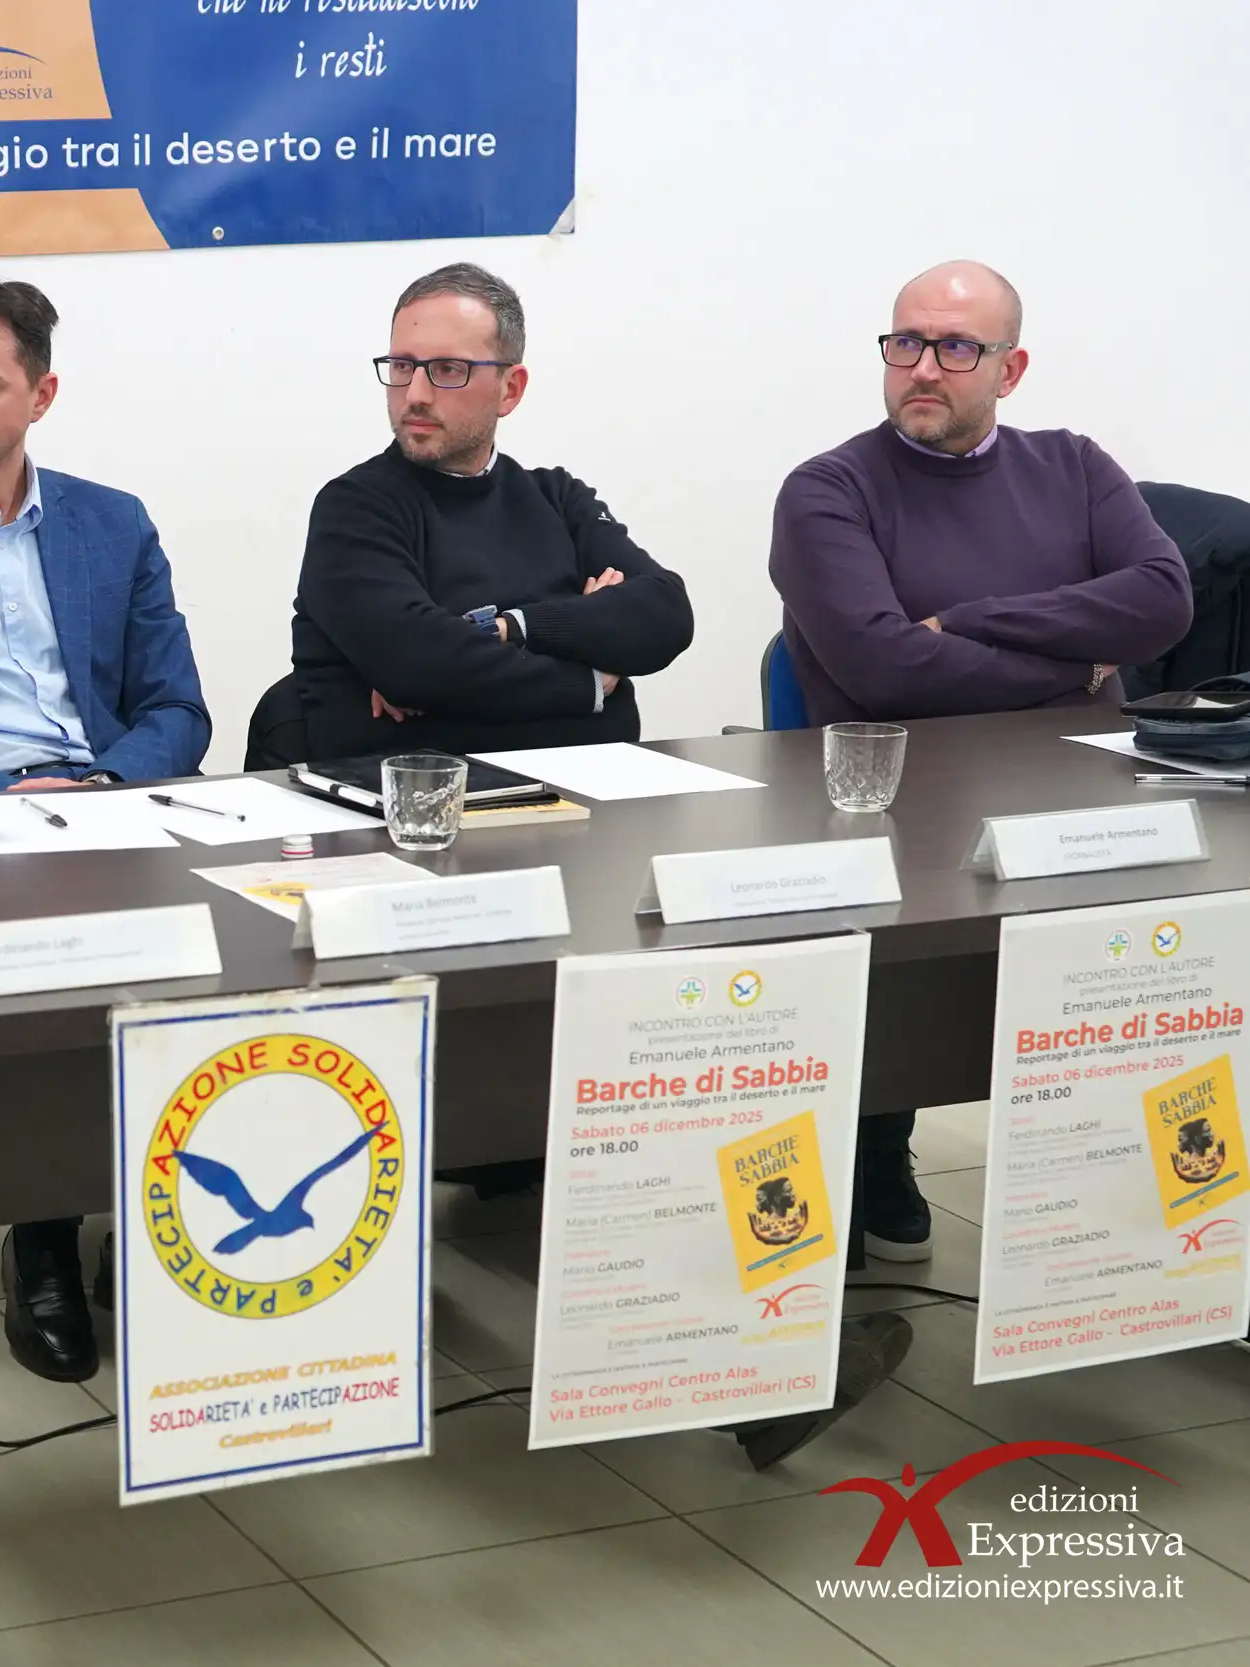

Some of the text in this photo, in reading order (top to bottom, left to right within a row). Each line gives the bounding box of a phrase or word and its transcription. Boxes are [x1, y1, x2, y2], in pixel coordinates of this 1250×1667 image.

[295, 32, 387, 78] i resti
[62, 137, 119, 168] tra
[133, 133, 151, 166] il
[166, 131, 321, 165] deserto
[336, 138, 356, 160] e
[371, 127, 389, 158] il
[405, 131, 496, 157] mare
[1063, 956, 1215, 985] INCONTRO CON L'AUTORE
[1062, 987, 1212, 1015] Emanuele Armentano
[629, 1008, 799, 1034] INCONTRO CON L'AUTORE
[1016, 1002, 1243, 1054] Barche di Sabbia
[630, 1040, 794, 1065] Emanuele Armentano
[1016, 1051, 1069, 1065] Reportage
[1072, 1049, 1081, 1059] di
[1084, 1049, 1096, 1057] un
[1099, 1043, 1135, 1056] viaggio
[1138, 1041, 1151, 1050] tra
[1153, 1038, 1159, 1047] il
[1161, 1034, 1198, 1047] deserto
[1209, 1031, 1215, 1040] il
[1217, 1028, 1241, 1038] mare
[577, 1056, 829, 1104] Barche di Sabbia
[1012, 1055, 1184, 1089] Sabato 06 dicembre 2025
[577, 1084, 826, 1116] Reportage di un viaggio tra il deserto e il mare
[1011, 1086, 1072, 1105] ore 18.00
[1158, 1077, 1217, 1115] BARCHE
[1162, 1094, 1217, 1128] SABBIA
[571, 1110, 763, 1140] Sabato 06 dicembre 2025
[1070, 1118, 1101, 1133] LAGHI
[570, 1141, 638, 1158] ore 18.00
[734, 1134, 800, 1173] BARCHE
[1086, 1144, 1143, 1161] BELMONTE
[150, 1042, 276, 1314] PARTECIPAZIONE
[636, 1176, 670, 1190] LAGHI
[739, 1153, 800, 1187] SABBIA
[654, 1202, 717, 1219] BELMONTE
[1035, 1199, 1078, 1214] GAUDIO
[1052, 1230, 1110, 1247] GRAZIADIO
[597, 1259, 645, 1273] GAUDIO
[1097, 1260, 1162, 1278] ARMENTANO
[616, 1292, 680, 1309] GRAZIADIO
[666, 1324, 738, 1342] ARMENTANO
[992, 1345, 1015, 1357] Via
[1019, 1336, 1063, 1353] Ettore
[1067, 1330, 1103, 1345] Gallo
[1120, 1313, 1202, 1337] Castrovillari
[1206, 1306, 1232, 1325] (CS)
[993, 1299, 1180, 1339] Sala Convegni Centro Alas
[149, 1351, 398, 1400] ASSOCIAZIONE CITTADINA
[551, 1366, 758, 1403] Sala Convegni Centro Alas
[150, 1377, 400, 1433] SOLIDARIETA' e PARTECIPAZIONE
[549, 1408, 574, 1423] Via
[579, 1402, 628, 1419] Ettore
[632, 1396, 672, 1411] Gallo
[692, 1380, 782, 1404] Castrovillari
[786, 1375, 816, 1394] (CS)
[219, 1418, 332, 1449] Castrovillari
